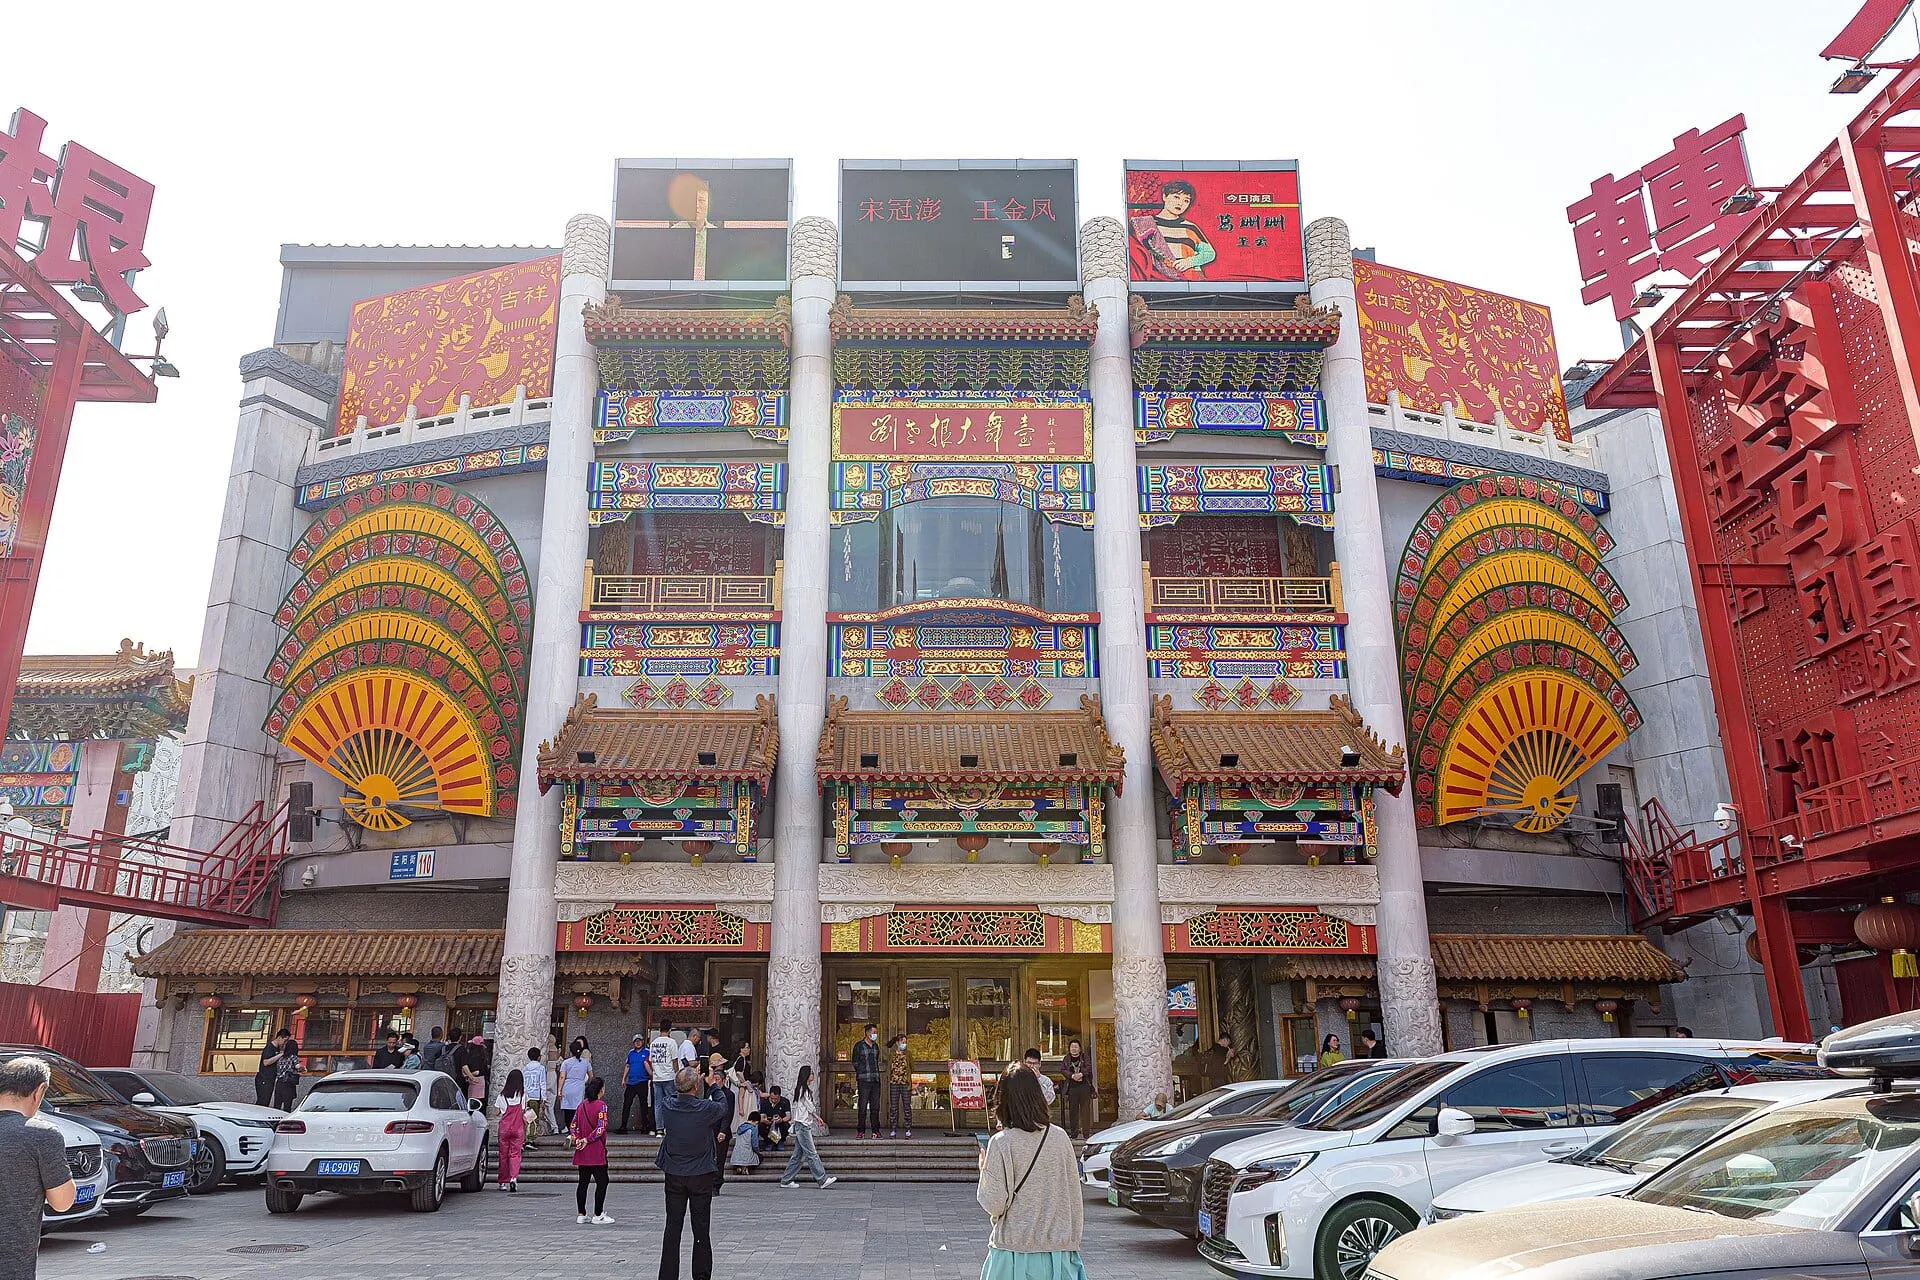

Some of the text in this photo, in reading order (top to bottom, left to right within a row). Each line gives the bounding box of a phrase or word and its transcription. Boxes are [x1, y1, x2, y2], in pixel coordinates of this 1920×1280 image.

[972, 197, 1056, 222] 王金凤
[1226, 193, 1272, 203] 今日演员
[499, 284, 549, 312] 吉祥
[1363, 287, 1412, 316] 如意
[418, 853, 432, 875] 110
[600, 912, 730, 943] 赶大集
[900, 912, 1031, 944] 过大年
[1205, 914, 1336, 944] 唱大戏
